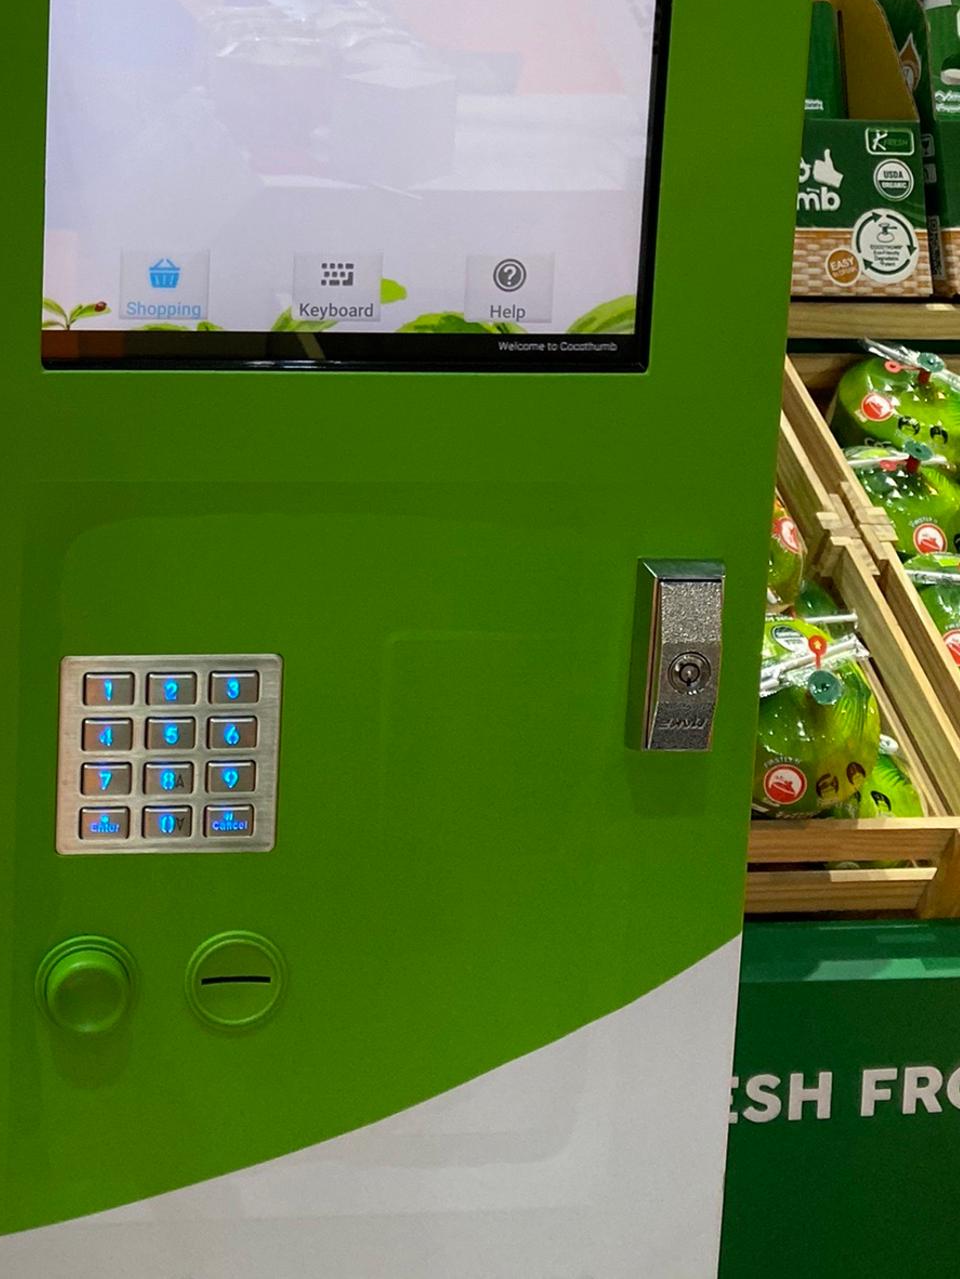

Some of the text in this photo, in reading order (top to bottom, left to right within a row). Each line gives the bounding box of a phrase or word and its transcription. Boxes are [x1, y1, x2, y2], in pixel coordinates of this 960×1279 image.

[883, 171, 903, 179] USDA
[127, 301, 201, 318] Shopping
[299, 303, 373, 320] Keyboard
[490, 305, 526, 322] Help
[498, 341, 545, 352] Welcome
[547, 341, 558, 352] to
[104, 677, 240, 701] 1 2 3
[99, 723, 240, 747] 4 5 6
[99, 769, 239, 791] 7 8 9
[160, 814, 175, 833] 0
